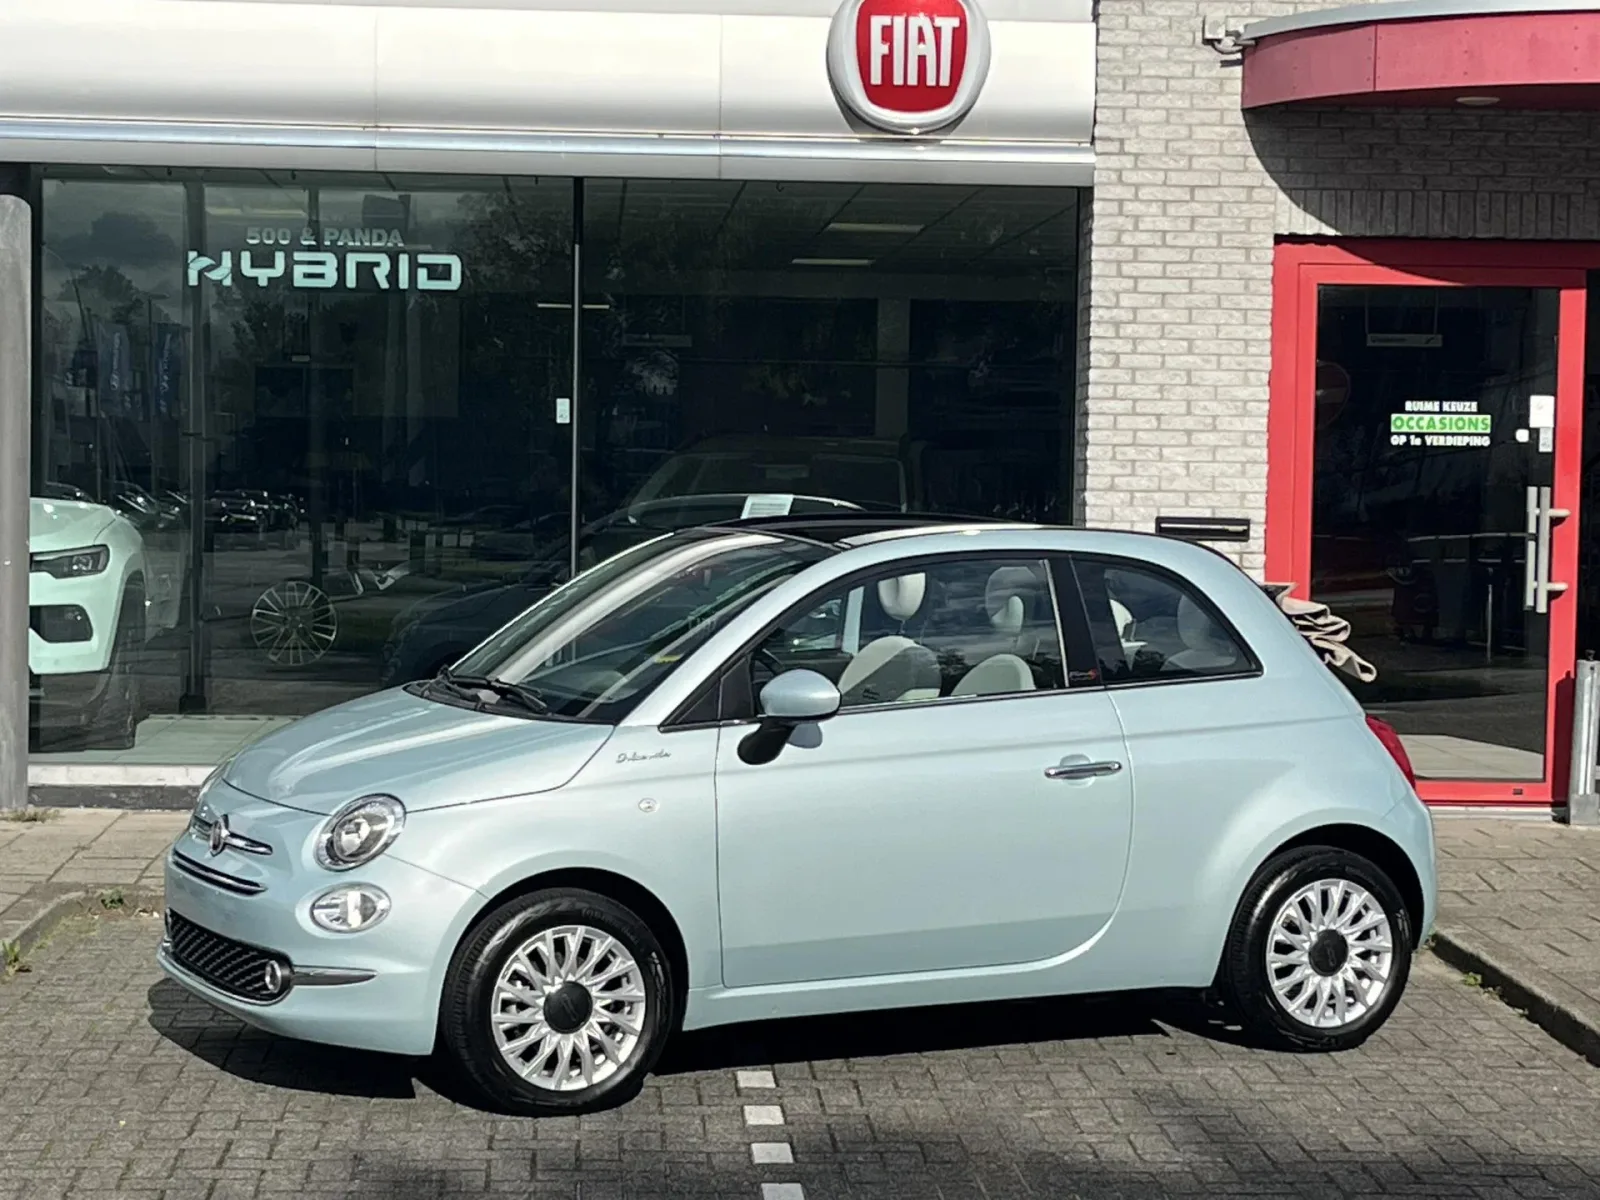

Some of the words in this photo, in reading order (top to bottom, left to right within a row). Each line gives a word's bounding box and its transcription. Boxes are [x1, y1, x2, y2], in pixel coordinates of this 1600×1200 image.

[870, 13, 960, 87] FIAT
[246, 227, 291, 245] 500
[300, 227, 317, 245] &
[323, 228, 404, 247] PANDA
[187, 250, 462, 291] HYBRID
[1405, 400, 1440, 412] RUIME
[1442, 401, 1478, 412] KEUZE
[1392, 416, 1490, 431] OCCASIONS
[1390, 434, 1407, 446] OP
[1424, 435, 1491, 447] VERDIEPING
